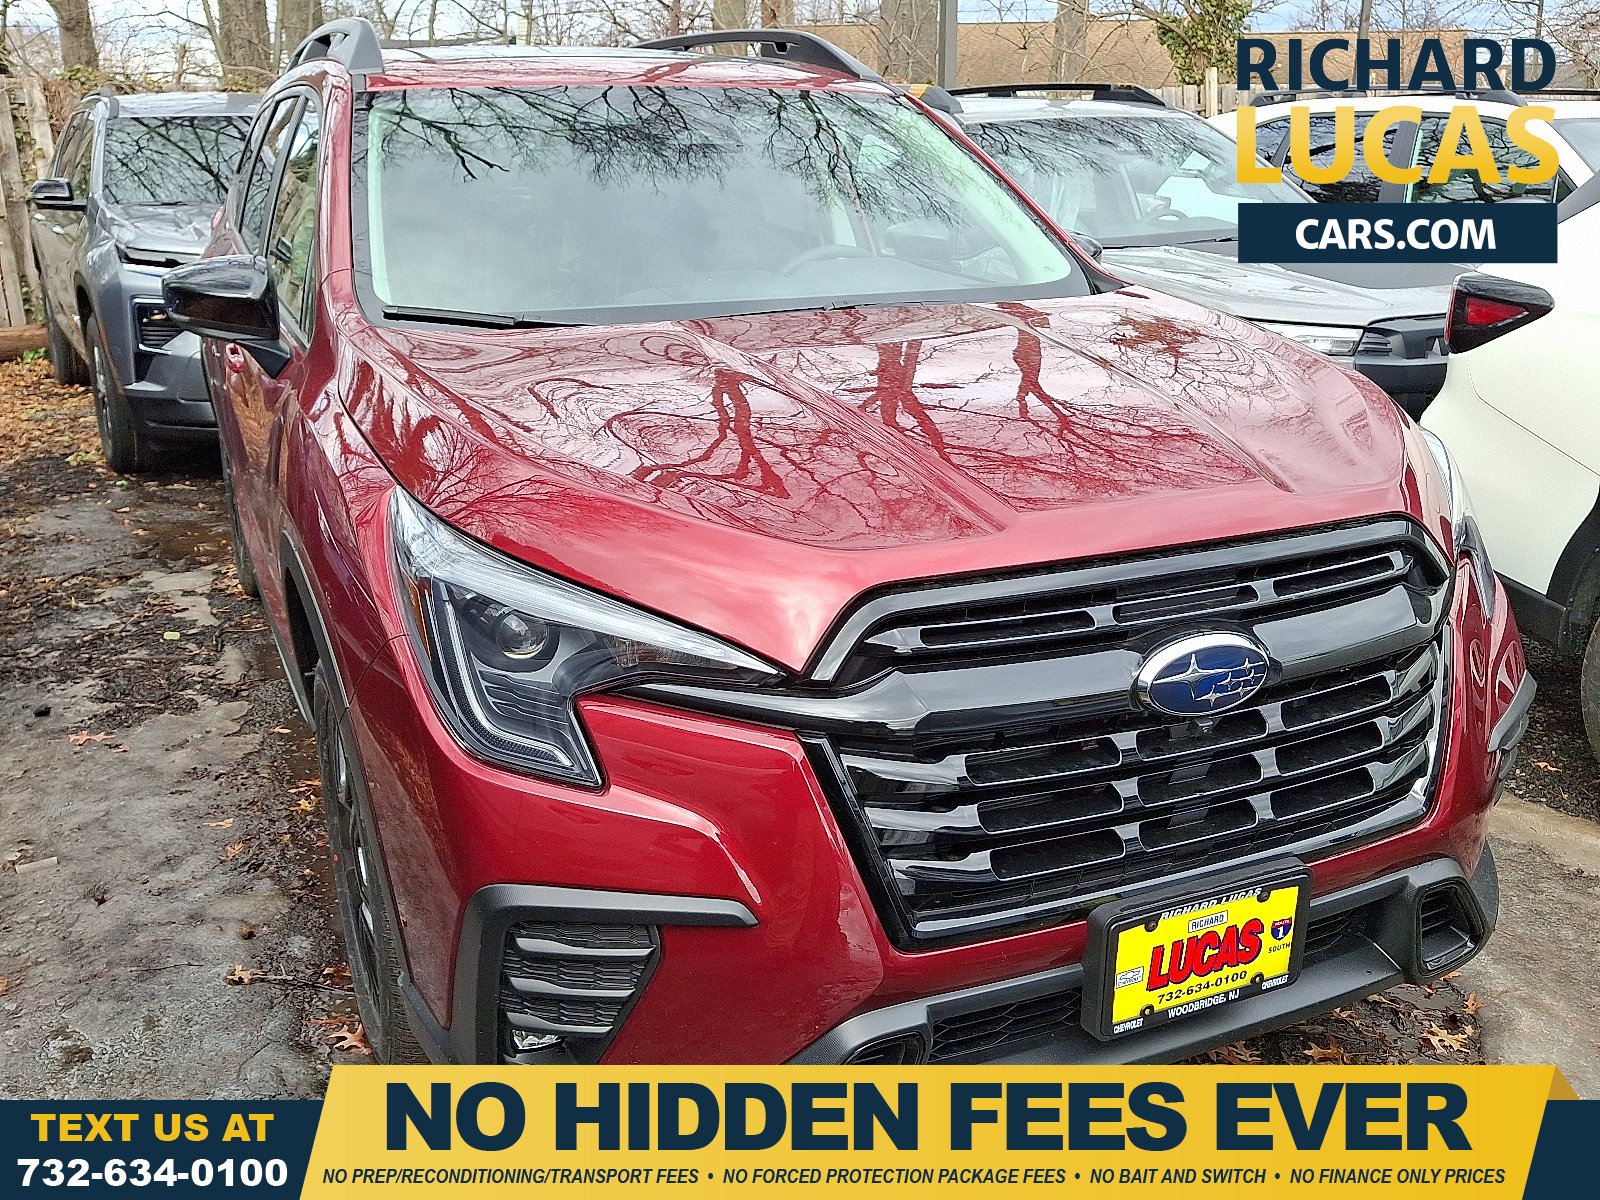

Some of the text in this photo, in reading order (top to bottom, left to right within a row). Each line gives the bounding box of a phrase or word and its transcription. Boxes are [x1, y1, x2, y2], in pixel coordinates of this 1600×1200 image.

[1160, 887, 1263, 921] RICHARD LUCAS
[1191, 913, 1225, 931] RICHARD
[1276, 925, 1285, 939] 1
[1146, 918, 1265, 991] LUCAS
[1268, 942, 1291, 954] SOUTH
[1157, 970, 1247, 1004] 732-634-0100
[1228, 989, 1240, 1003] NJ
